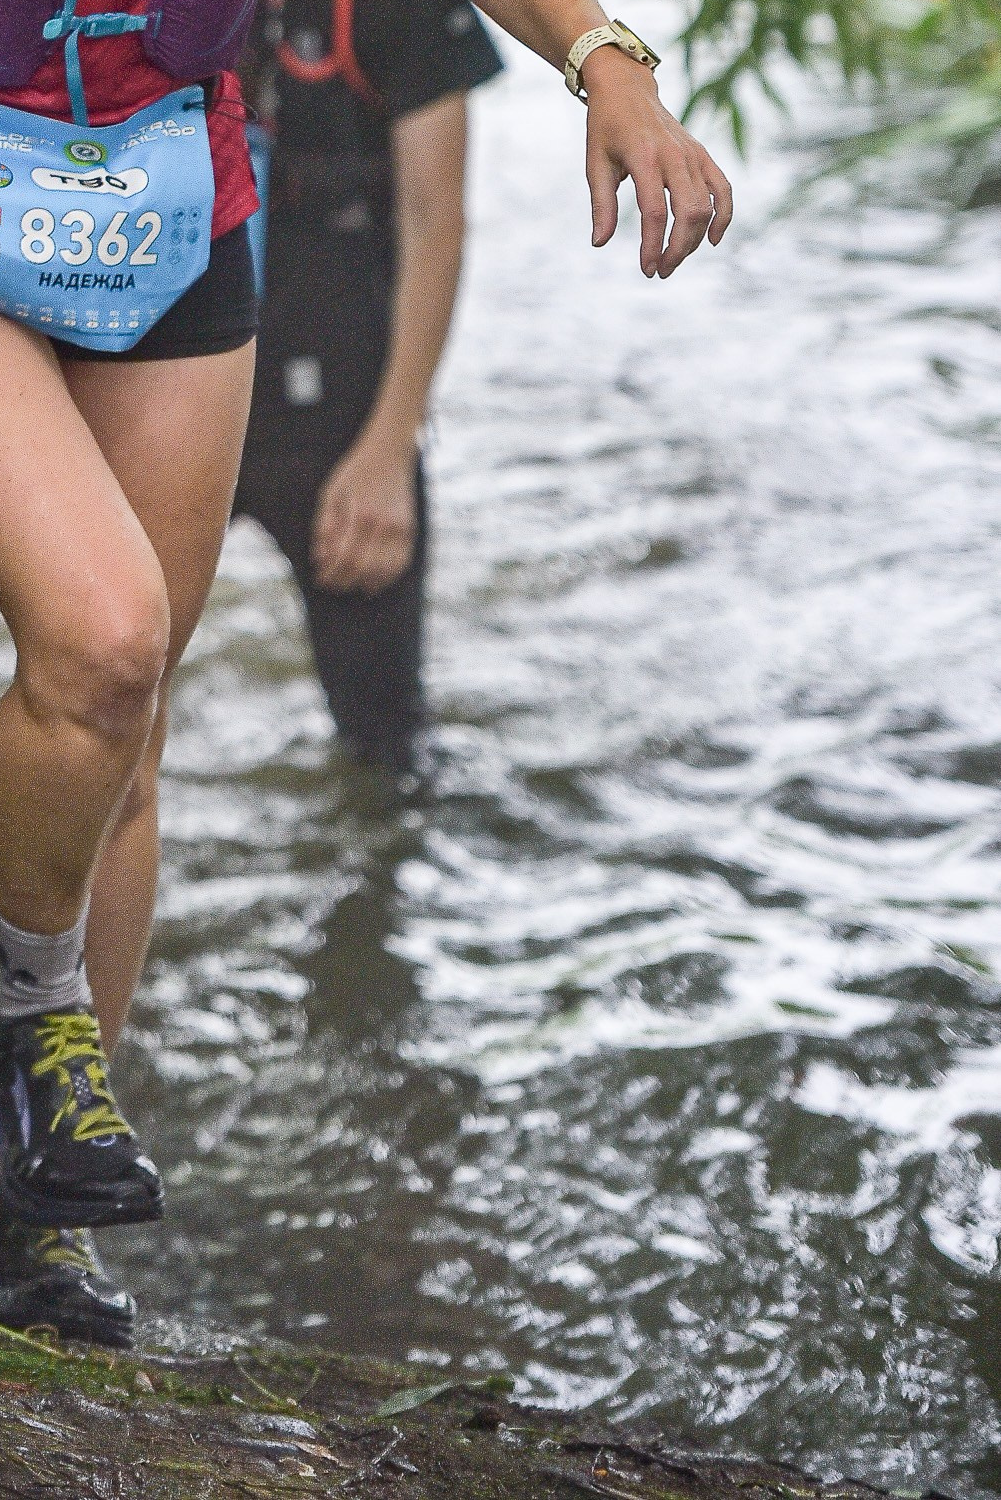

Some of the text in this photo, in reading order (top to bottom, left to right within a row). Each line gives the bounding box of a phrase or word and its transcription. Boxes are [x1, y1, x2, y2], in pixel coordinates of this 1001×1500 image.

[161, 125, 196, 137] 100
[20, 207, 163, 267] 8362
[38, 270, 137, 293] НАДЕЖДА
